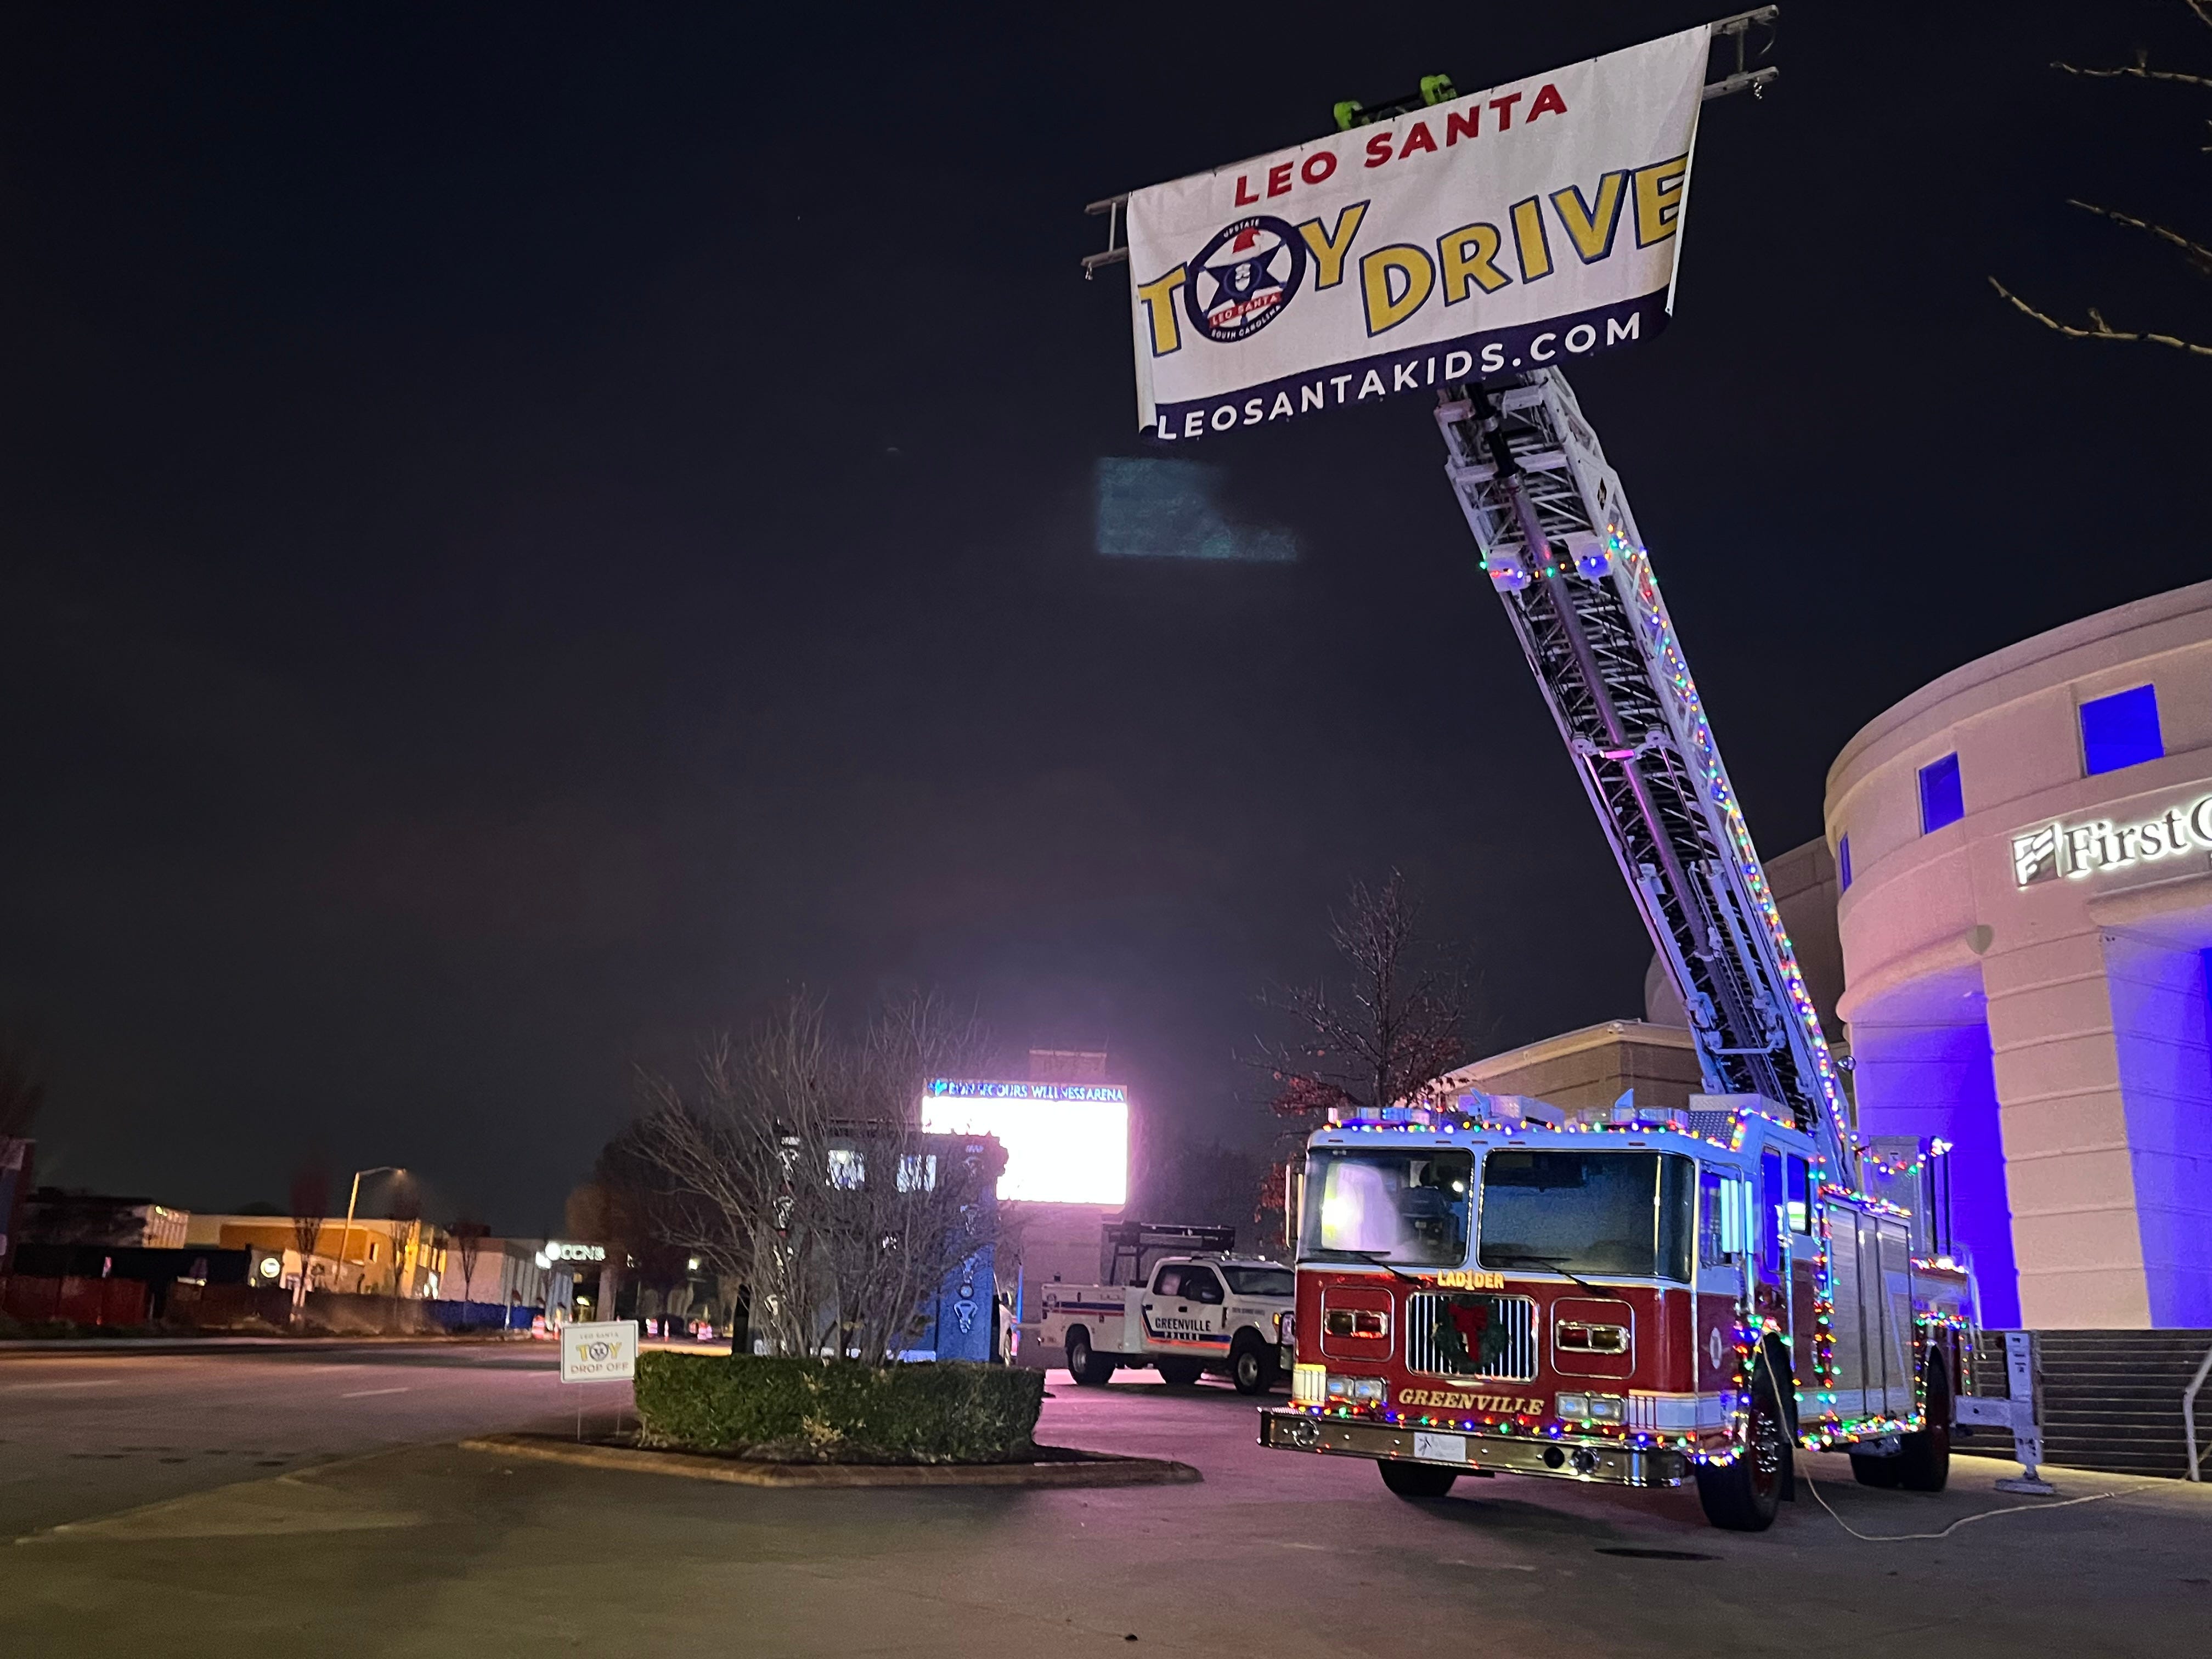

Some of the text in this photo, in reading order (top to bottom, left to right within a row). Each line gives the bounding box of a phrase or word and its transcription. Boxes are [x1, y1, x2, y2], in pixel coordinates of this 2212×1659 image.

[1234, 83, 1568, 208] LEO SANTA
[1223, 218, 1260, 238] UPSTATE
[1137, 151, 1690, 358] TOY DRIVE
[1211, 304, 1281, 340] SOUTH CAROLINA
[1212, 295, 1280, 325] LEO SANTA
[1156, 312, 1642, 441] LEOSANTAKIDS.COM
[1086, 1088, 1124, 1102] ARENA
[1155, 1317, 1212, 1332] GREENVILLE
[571, 1362, 629, 1374] DROP OFF
[1398, 1388, 1545, 1415] GREENVILLE
